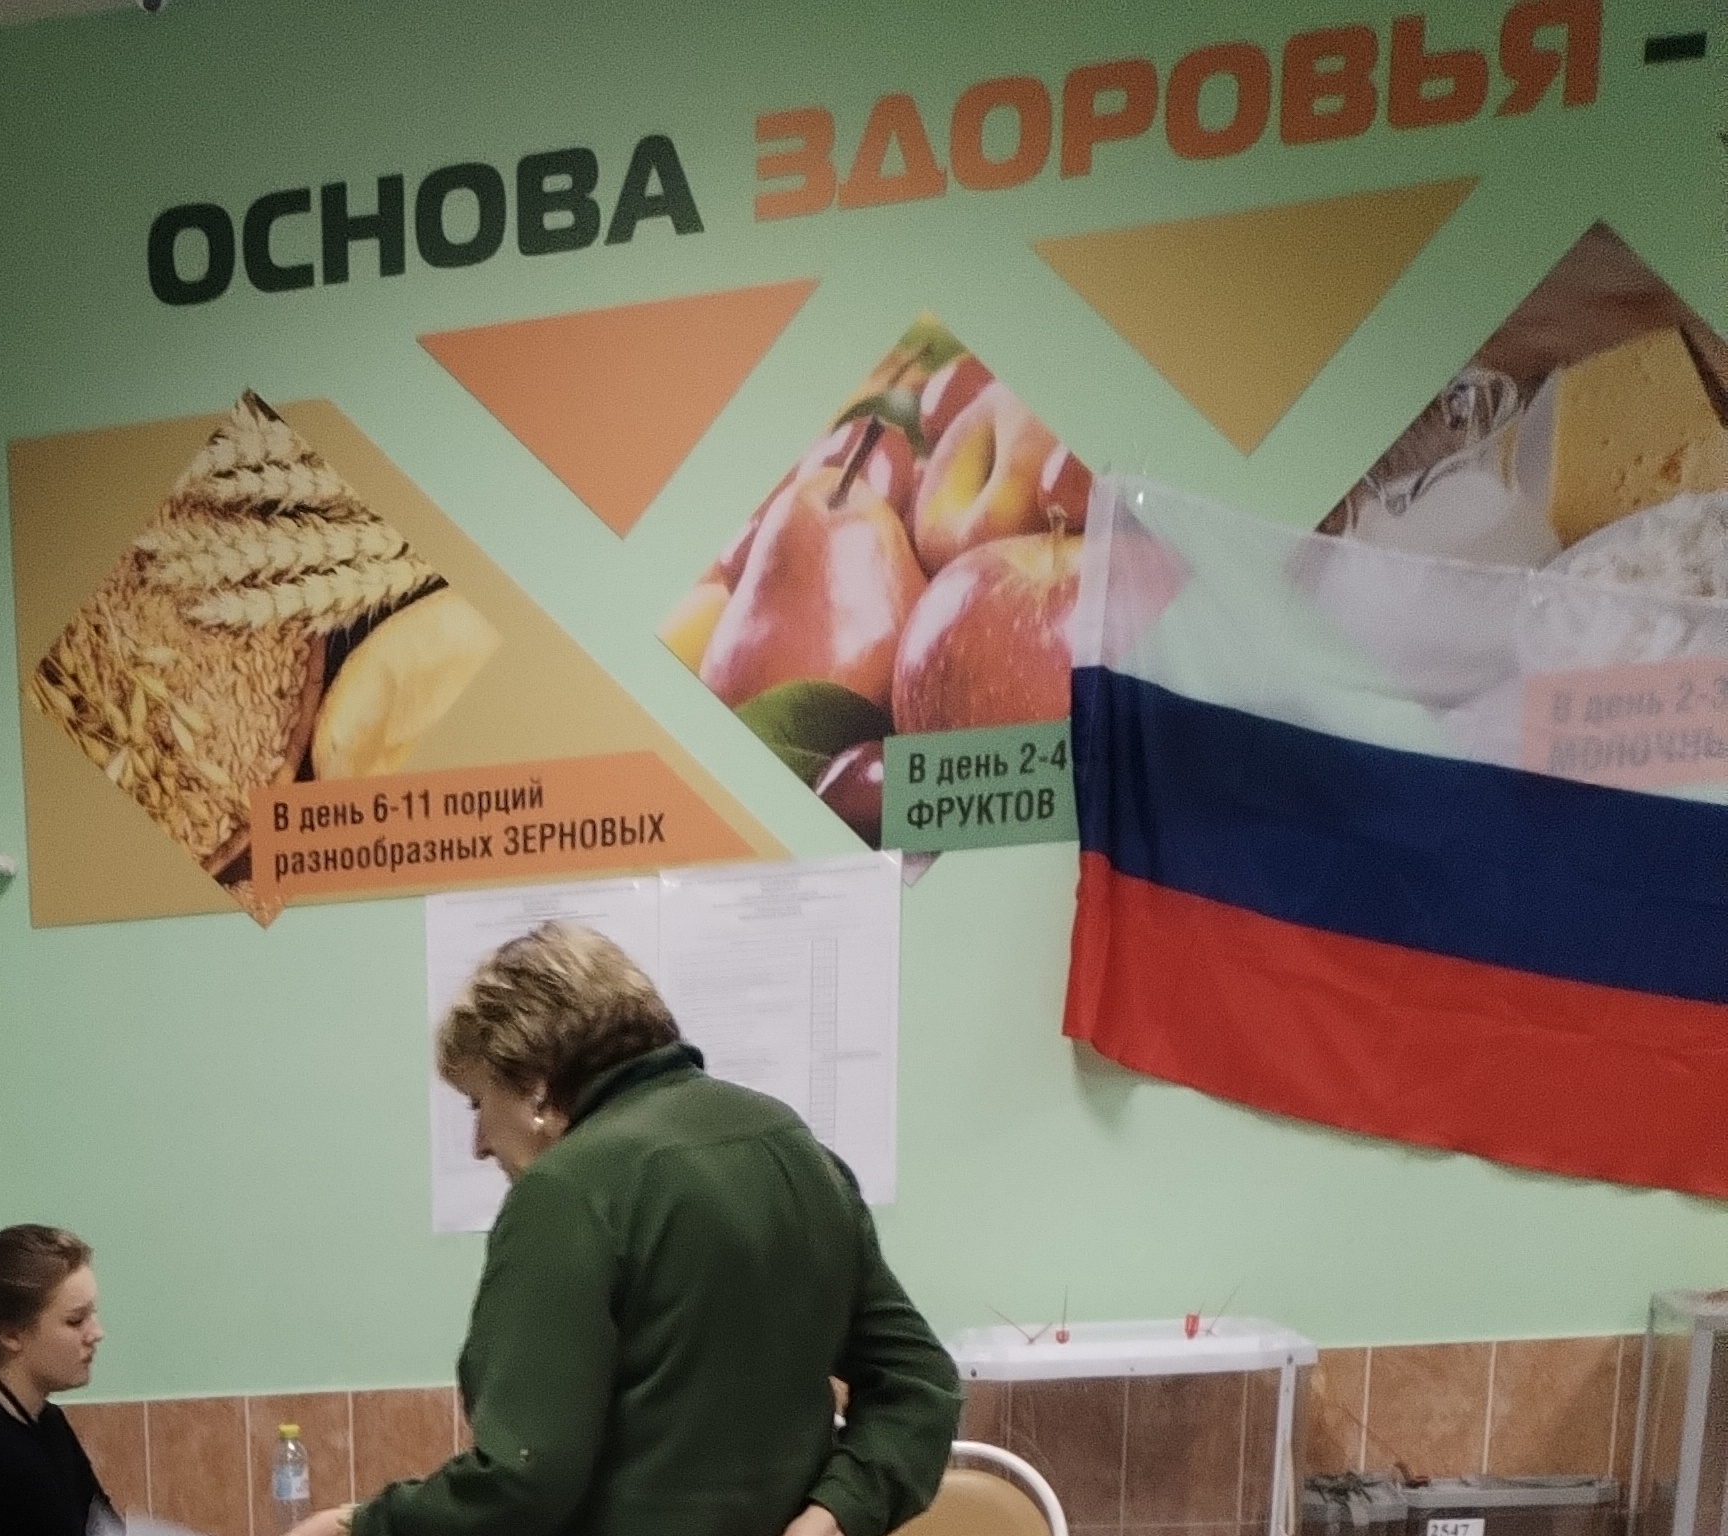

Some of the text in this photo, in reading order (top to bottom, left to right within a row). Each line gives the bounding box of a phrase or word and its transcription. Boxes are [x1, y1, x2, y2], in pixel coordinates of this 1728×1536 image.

[146, 134, 705, 308] ОСНОВА
[752, 0, 1604, 224] ЗДОРОВЬЯ
[909, 740, 1068, 786] В день 2-4
[273, 778, 545, 833] В день 6-11 порций
[907, 787, 1055, 830] ФРУКТОВ
[274, 812, 666, 883] разнообразных ЗЕРНОВЫХ
